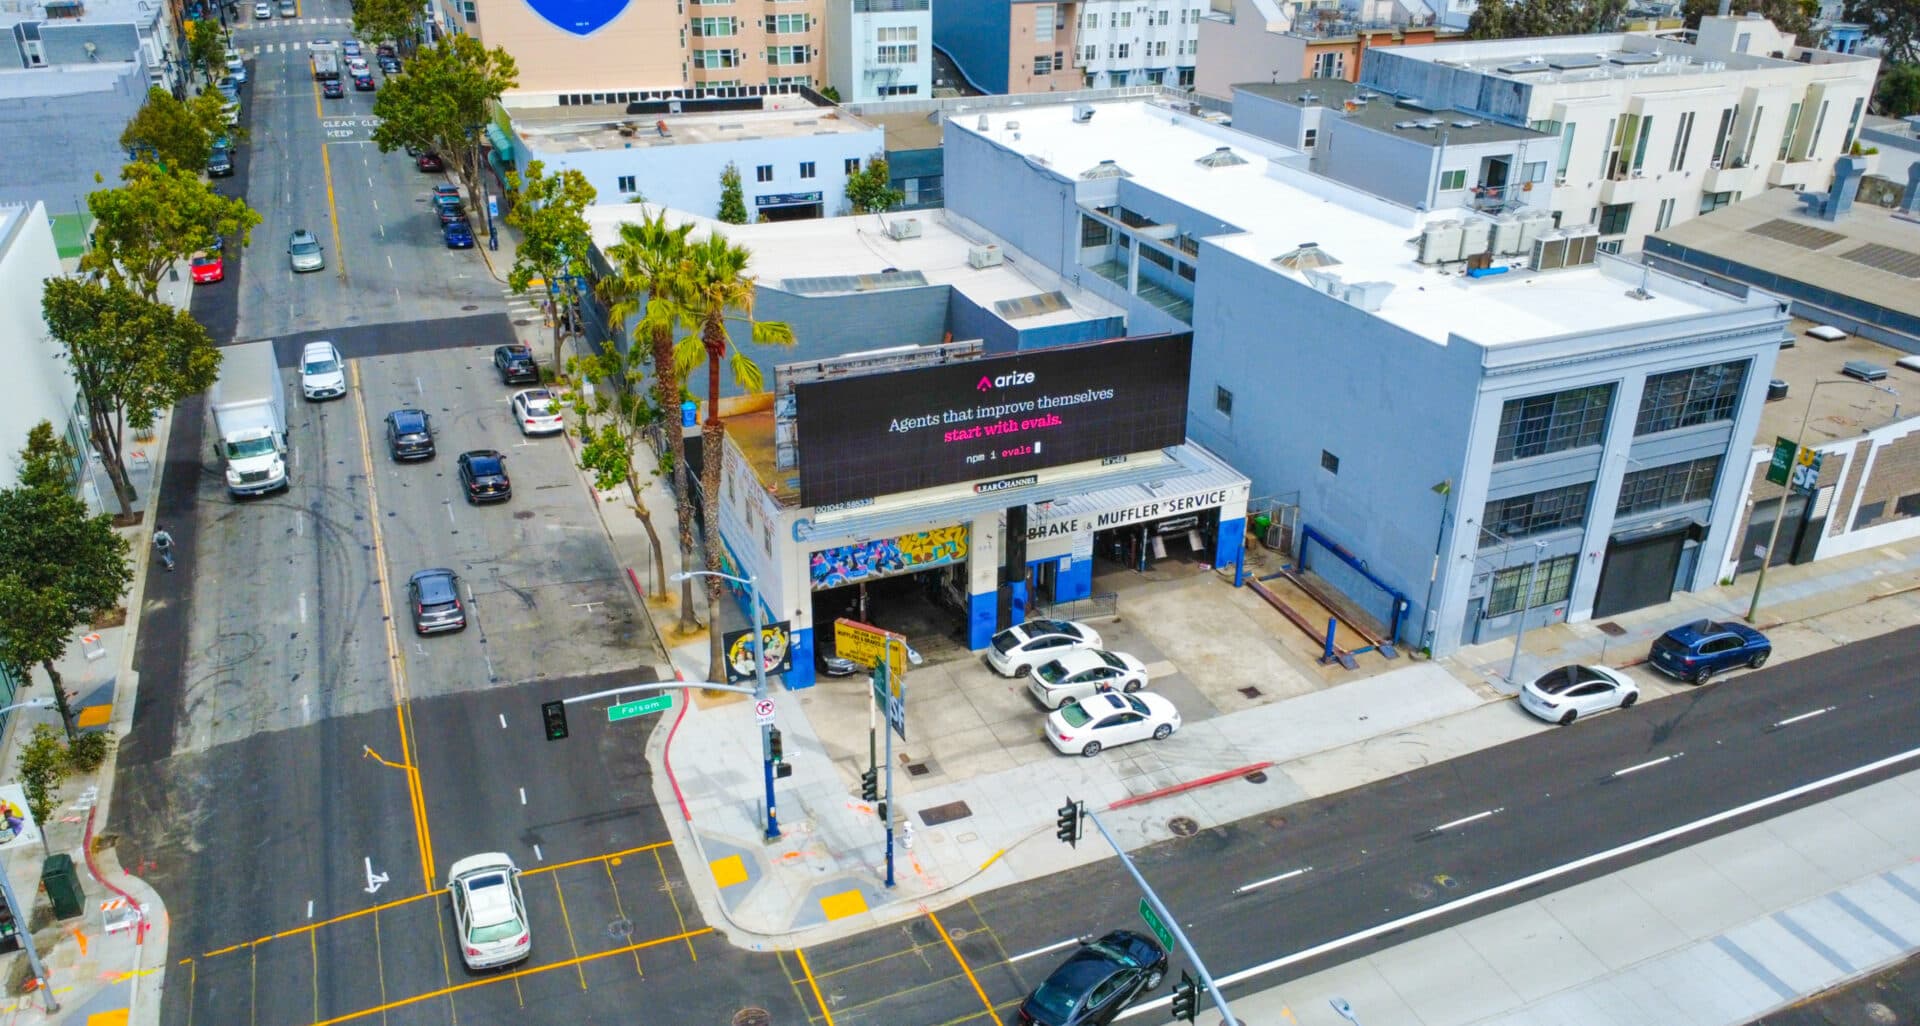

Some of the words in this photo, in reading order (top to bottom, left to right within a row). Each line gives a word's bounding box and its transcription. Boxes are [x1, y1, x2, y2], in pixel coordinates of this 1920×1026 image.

[323, 120, 355, 128] CLEAR
[327, 129, 353, 137] KEEP
[994, 370, 1036, 389] arize
[888, 411, 940, 433] Agents
[943, 407, 974, 425] that
[976, 399, 1035, 421] improve
[1037, 387, 1114, 410] themselves
[944, 424, 981, 443] start
[983, 420, 1019, 437] with
[1021, 413, 1063, 432] evals.
[966, 454, 986, 464] npm
[1001, 445, 1032, 458] evals
[1793, 465, 1818, 489] SF
[1028, 519, 1078, 540] BRAKE
[1097, 503, 1159, 527] MUFFLER
[1168, 490, 1226, 512] SERVICE
[621, 701, 660, 715] Folsom
